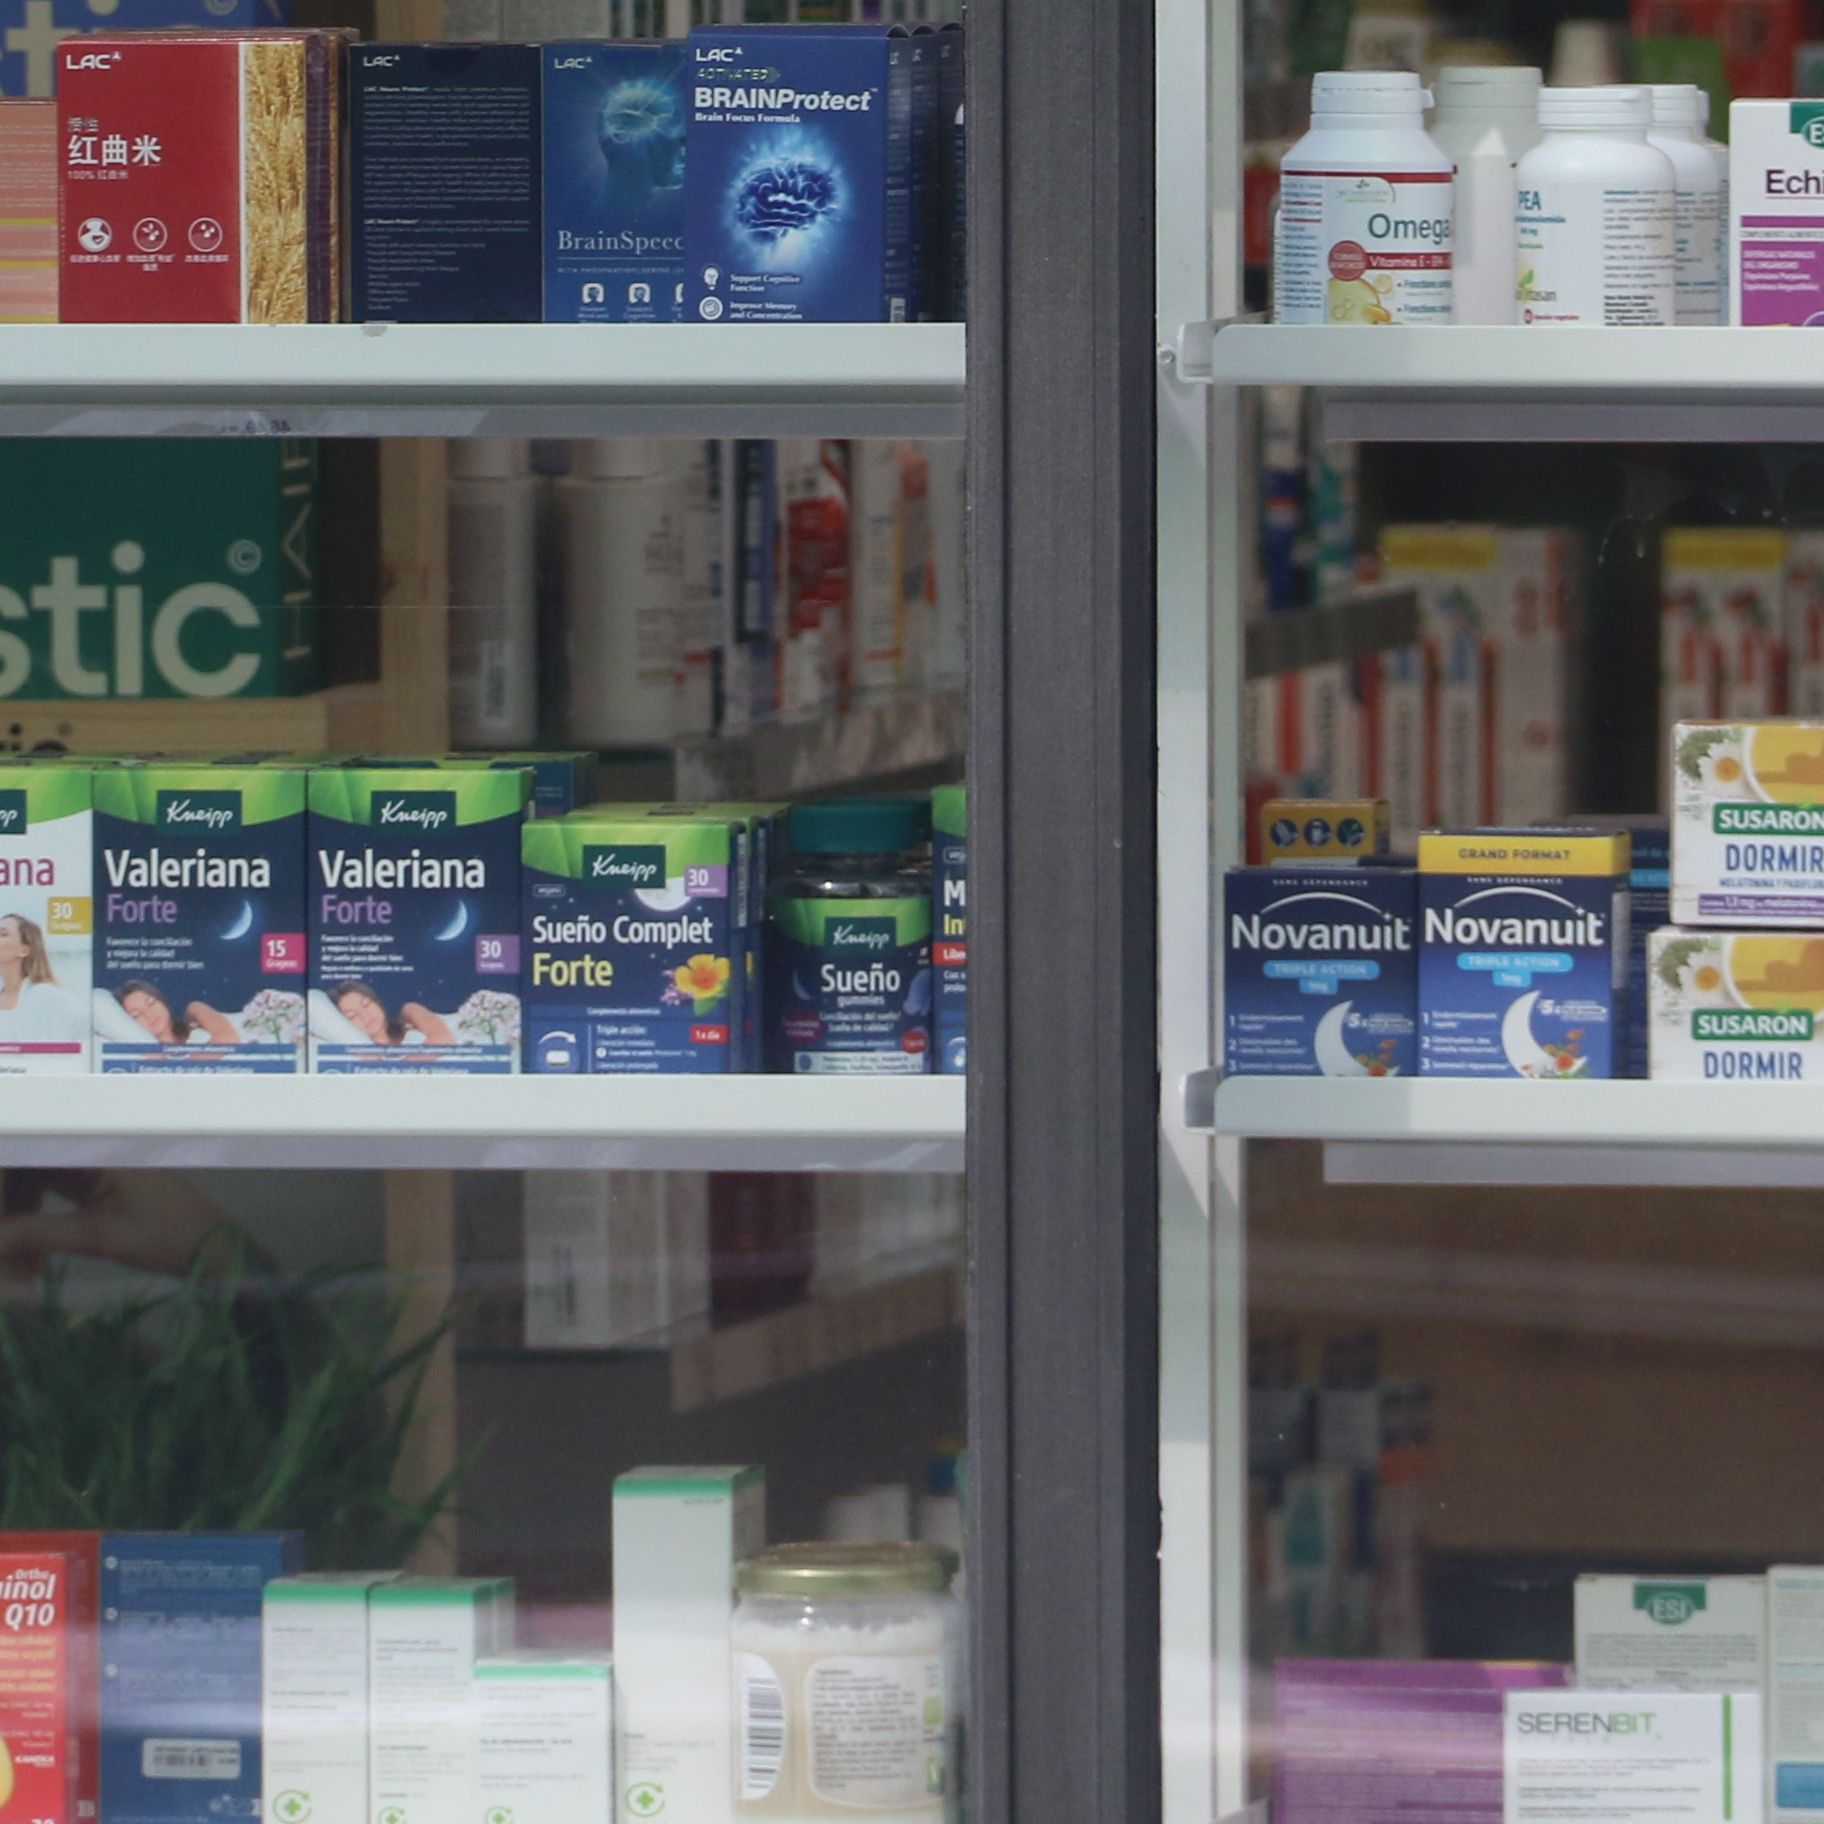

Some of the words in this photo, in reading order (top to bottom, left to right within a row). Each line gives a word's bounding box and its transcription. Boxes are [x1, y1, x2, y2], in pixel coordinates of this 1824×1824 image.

[694, 88, 872, 112] BRAINProtect
[726, 112, 756, 122] Focus
[68, 135, 162, 166] 红曲米
[1367, 213, 1450, 244] Omega
[166, 799, 233, 827] Kneipp
[380, 800, 448, 827] Kneipp
[104, 848, 271, 889] Valeriana
[1459, 848, 1507, 860] GRAND
[1513, 848, 1571, 861] FORMAT
[1725, 844, 1824, 873] DORMIR
[318, 849, 485, 889] Valeriana
[687, 869, 709, 886] 30
[52, 902, 72, 920] 30
[107, 893, 177, 923] Forte
[320, 894, 392, 923] Forte
[532, 915, 607, 944] Sueño
[612, 915, 712, 945] Complet
[1233, 911, 1412, 951] Novanuit
[1424, 907, 1605, 946] Novanuit
[266, 940, 286, 958] 15
[480, 941, 501, 958] 30
[532, 952, 614, 987] Forte
[820, 963, 901, 994] Sueño
[1697, 1014, 1809, 1035] SUSARON
[1704, 1051, 1803, 1079] DORMIR
[4, 1603, 54, 1628] Q10
[1652, 1599, 1688, 1620] ESI
[1517, 1712, 1657, 1735] SERENBIT
